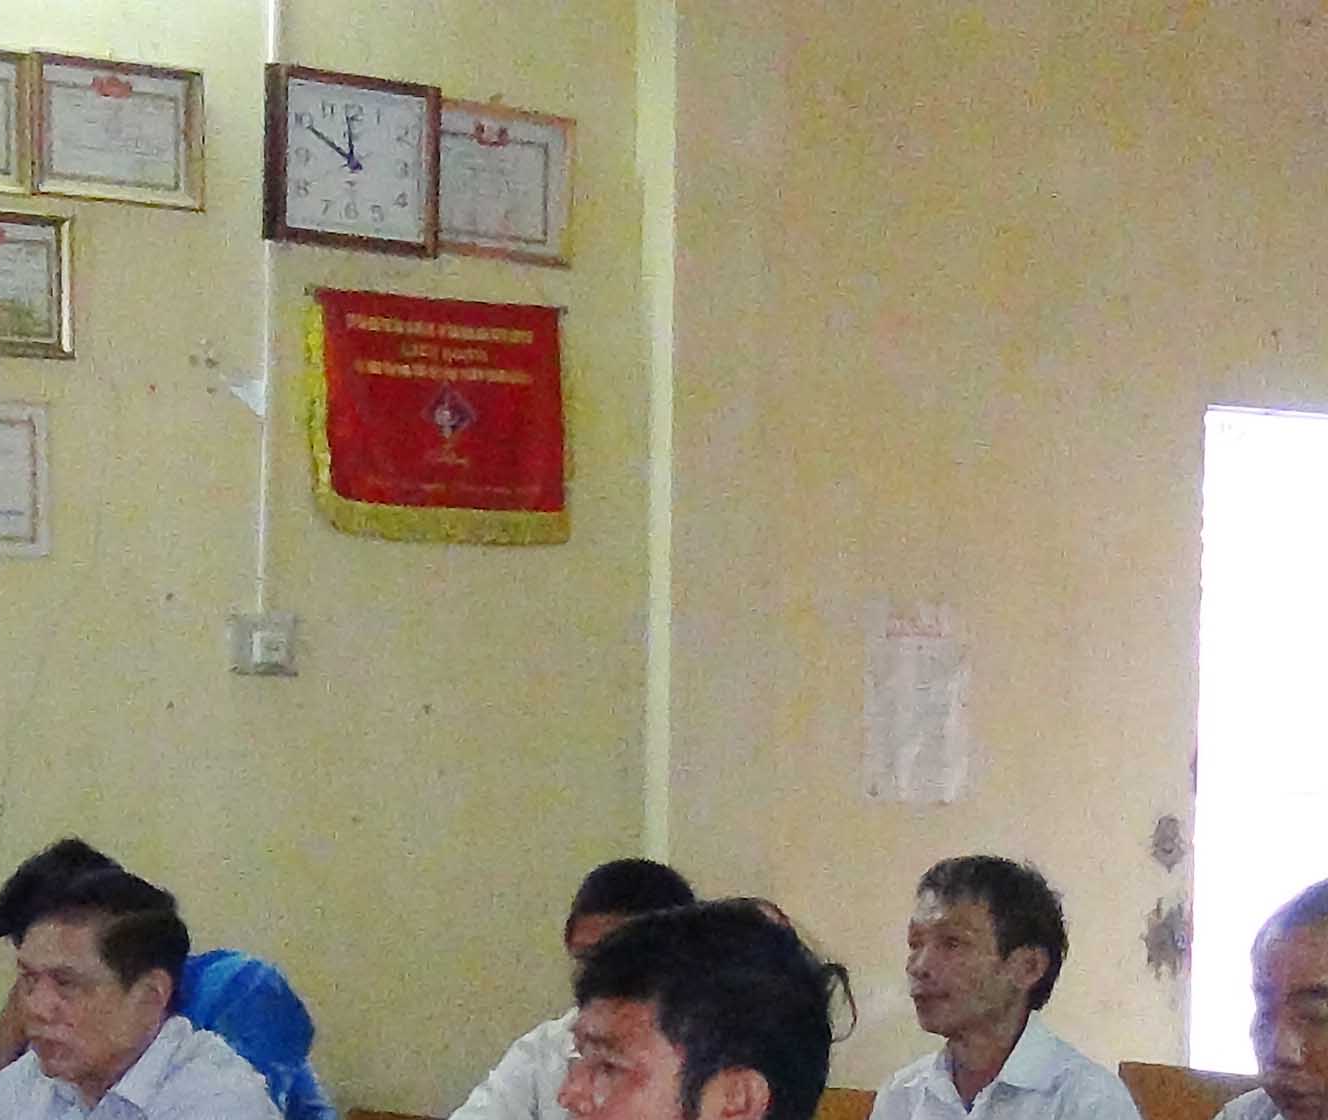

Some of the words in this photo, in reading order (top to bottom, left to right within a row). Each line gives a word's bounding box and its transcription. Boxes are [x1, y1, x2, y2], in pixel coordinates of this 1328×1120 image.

[321, 101, 336, 118] 11
[294, 111, 314, 127] 10
[320, 199, 333, 216] 7
[392, 191, 409, 208] 4
[344, 201, 360, 220] 6
[371, 204, 385, 223] 5
